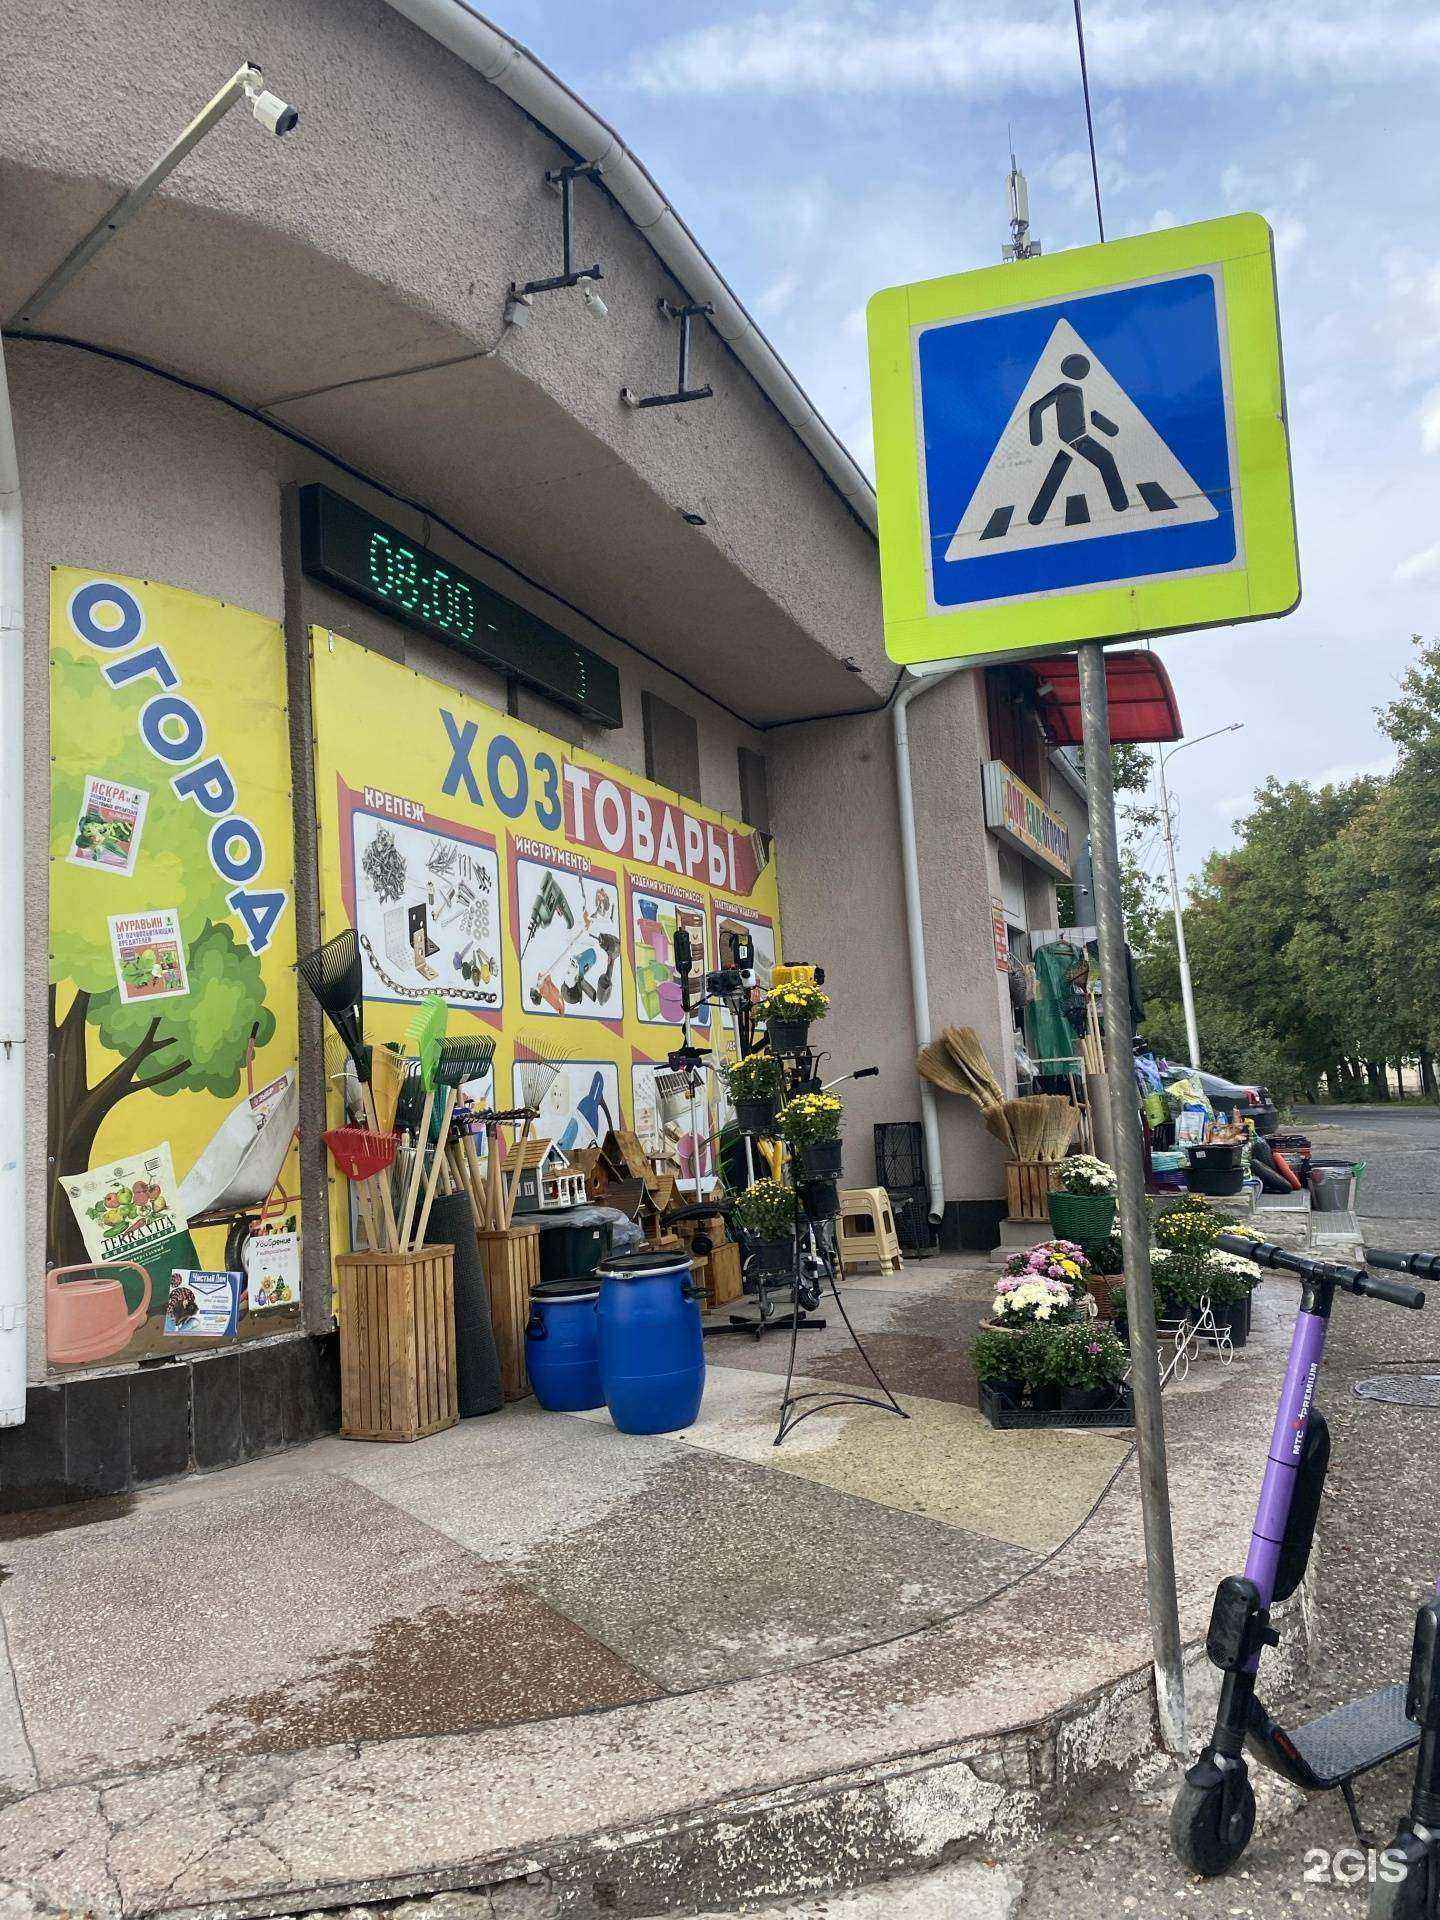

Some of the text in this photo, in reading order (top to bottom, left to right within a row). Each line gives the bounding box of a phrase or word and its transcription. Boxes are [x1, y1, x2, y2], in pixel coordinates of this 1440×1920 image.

[369, 532, 475, 639] 08:00
[71, 583, 287, 952] ОГОРОД
[91, 781, 125, 801] ИСКРА
[363, 786, 425, 823] КРЕПЕЖ
[438, 708, 737, 892] ХОЗТОВАРЫ
[514, 835, 592, 873] ИНСТРУМЕНТЫ
[630, 872, 658, 892] ИЗДЕЛИЯ
[658, 880, 667, 894] ИЗ
[116, 916, 163, 933] МУРАВЬИН
[1299, 1362, 1318, 1420] PREMIUM
